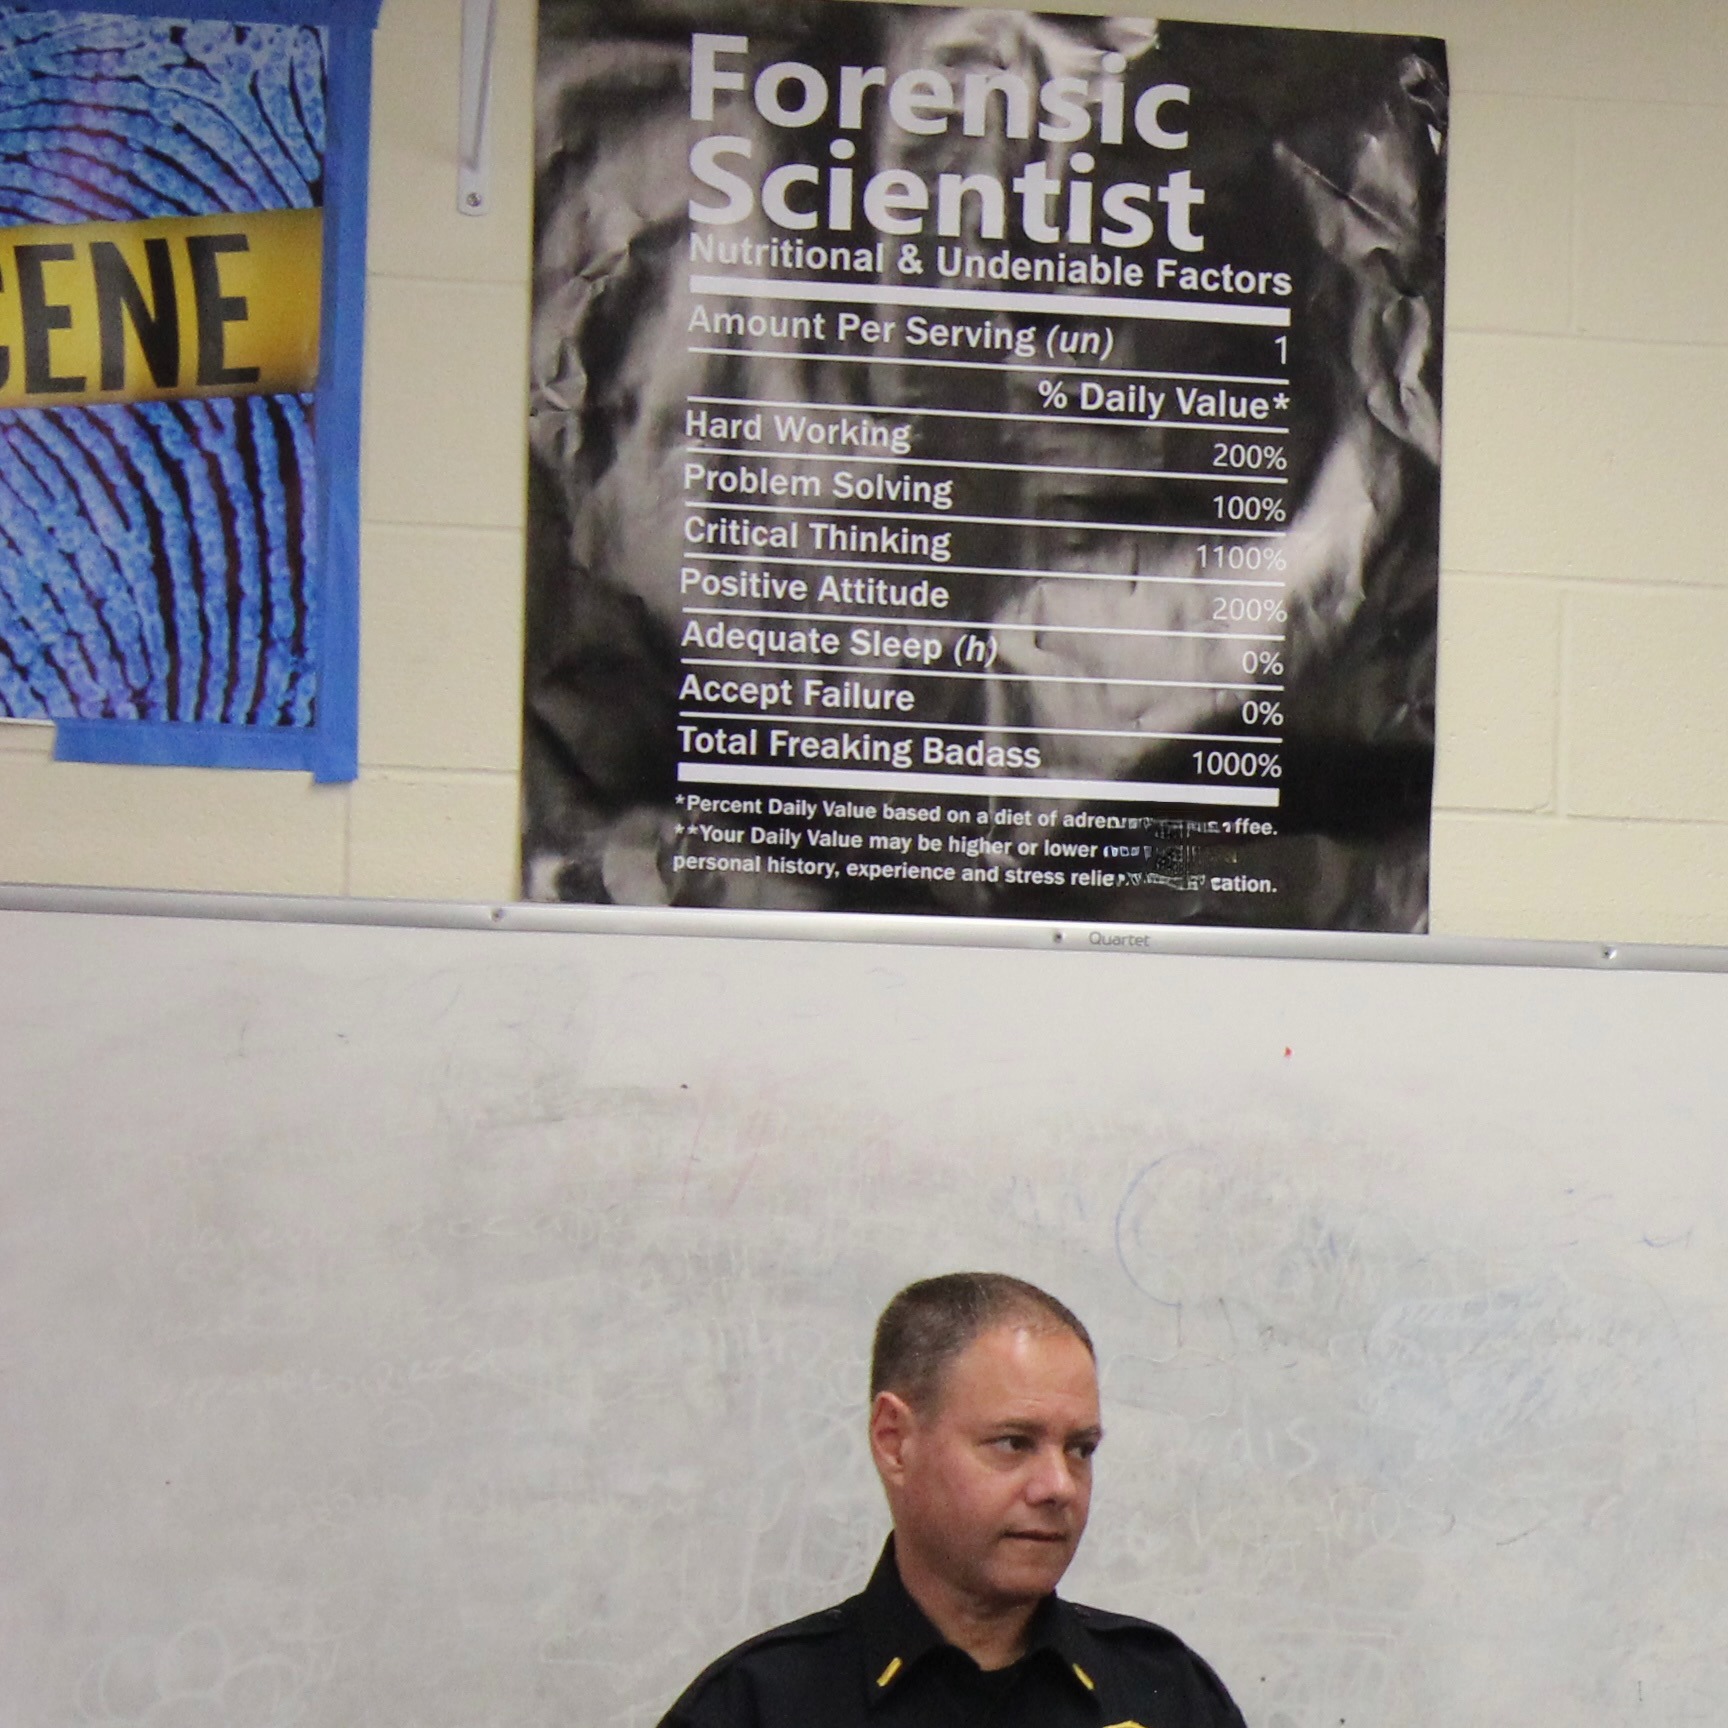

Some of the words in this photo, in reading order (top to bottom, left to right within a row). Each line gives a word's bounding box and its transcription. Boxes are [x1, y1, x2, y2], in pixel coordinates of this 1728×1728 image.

[690, 32, 1190, 149] Forensic
[688, 135, 1205, 252] Scientist
[688, 232, 884, 274] Nutritional
[898, 244, 924, 275] &
[938, 246, 1143, 288] Undeniable
[1156, 259, 1292, 296] Factors
[0, 234, 261, 393] ENE
[688, 305, 826, 341] Amount
[839, 312, 896, 344] Per
[907, 317, 1036, 357] Serving
[1046, 324, 1114, 359] (un)
[1274, 337, 1288, 365] 1
[1038, 380, 1067, 409] %
[1079, 383, 1165, 419] Daily
[685, 410, 762, 441] Hard
[773, 415, 912, 455] Working
[1212, 444, 1288, 470] 200%
[685, 467, 821, 498] Problem
[832, 473, 953, 510] Solving
[1212, 495, 1286, 523] 100%
[685, 516, 799, 549] Critical
[808, 523, 951, 561] Thinking
[1196, 544, 1287, 572] 1100%
[680, 568, 808, 600] Positive
[819, 575, 949, 608] Attitude
[1212, 597, 1288, 624] 200%
[681, 621, 840, 661] Adequate
[850, 628, 942, 664] Sleep
[954, 634, 998, 668] (h)
[1241, 650, 1284, 676] 0%
[680, 674, 793, 711] Accept
[803, 678, 915, 711] Failure
[1241, 700, 1284, 726] 0%
[678, 726, 758, 756] Total
[769, 729, 913, 769] Freaking
[922, 736, 1041, 769] Badass
[1191, 751, 1283, 779] 1000%
[768, 798, 817, 820] Daily
[822, 801, 877, 819] Value
[883, 803, 941, 822] based
[947, 809, 971, 824] on
[976, 810, 988, 825] a
[994, 809, 1032, 826] diet
[1038, 810, 1058, 827] of
[751, 826, 801, 849] Daily
[807, 829, 863, 848] Value
[869, 834, 912, 853] may
[917, 834, 942, 852] be
[949, 835, 1009, 858] higher
[1018, 841, 1037, 855] or
[1044, 839, 1098, 857] lower
[673, 853, 761, 873] personal
[767, 856, 840, 879] history,
[846, 861, 955, 881] experience
[961, 863, 999, 883] and
[1004, 869, 1065, 885] stress
[1089, 932, 1150, 949] Quartet
